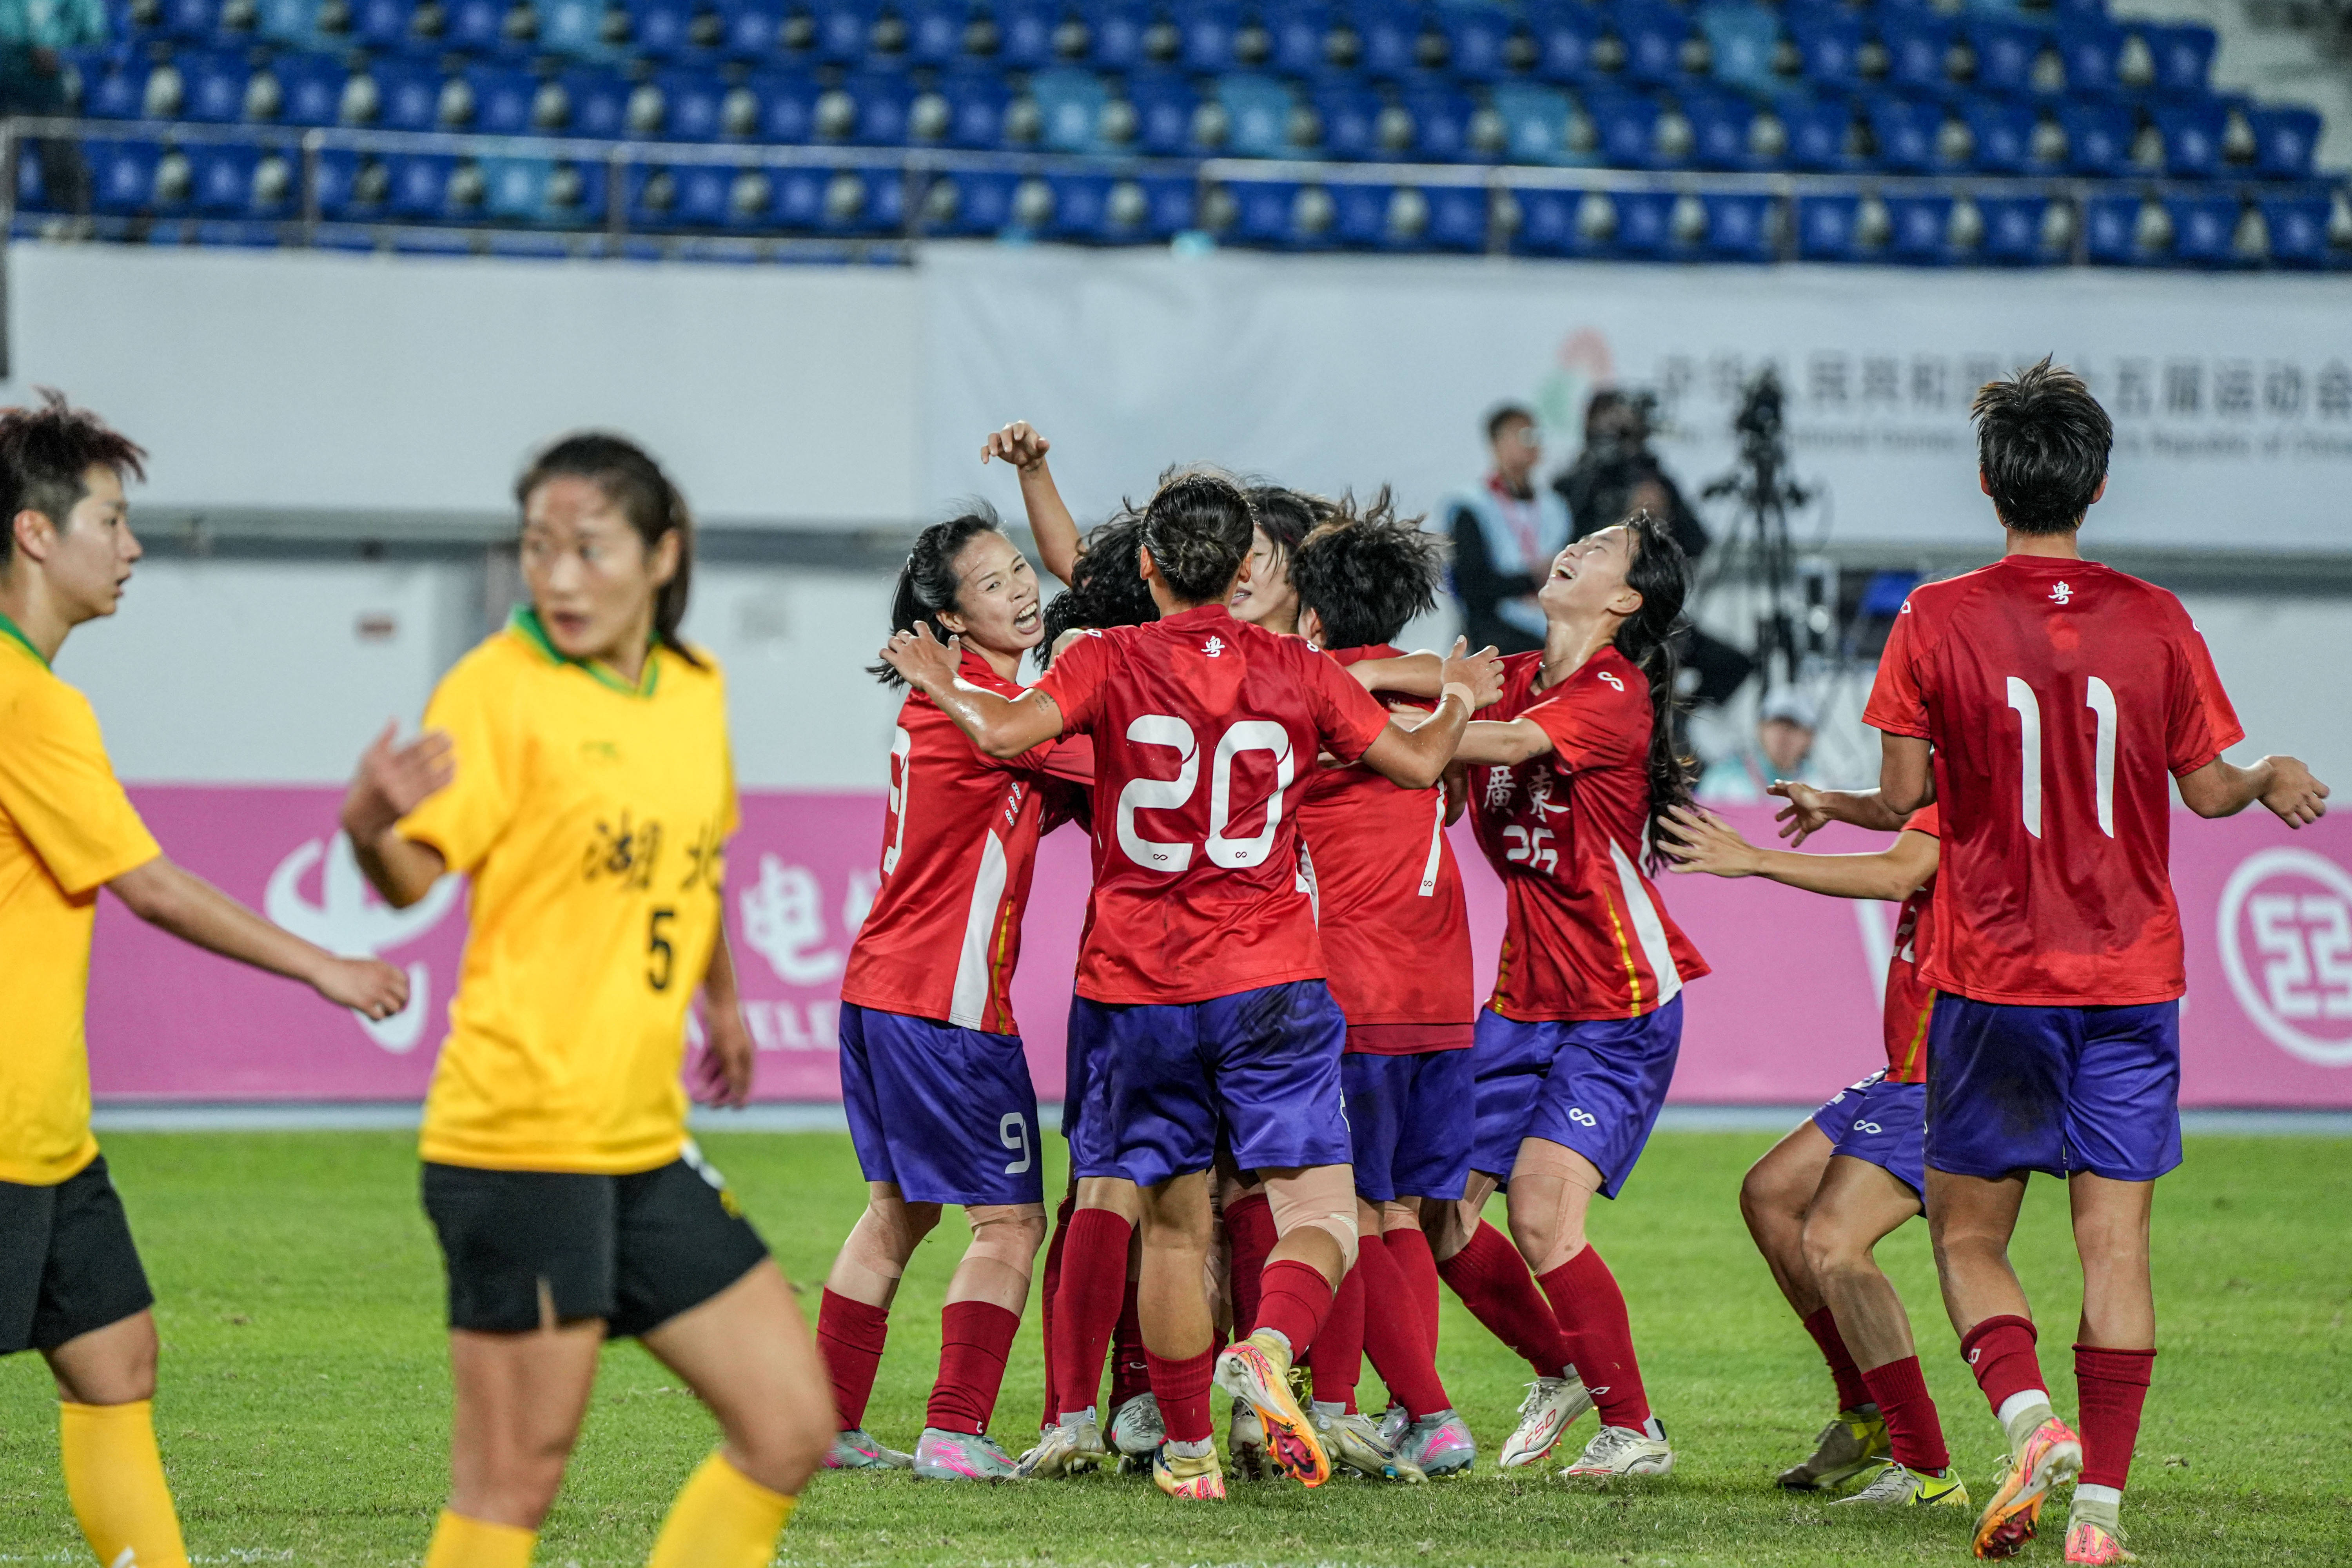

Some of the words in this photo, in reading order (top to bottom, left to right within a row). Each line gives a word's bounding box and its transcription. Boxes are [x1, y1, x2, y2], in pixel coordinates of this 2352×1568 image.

[1116, 714, 1294, 872] 20
[2007, 676, 2117, 839] 11
[647, 906, 675, 992] 5
[1000, 1112, 1031, 1174] 9
[1525, 1409, 1557, 1452] F50
